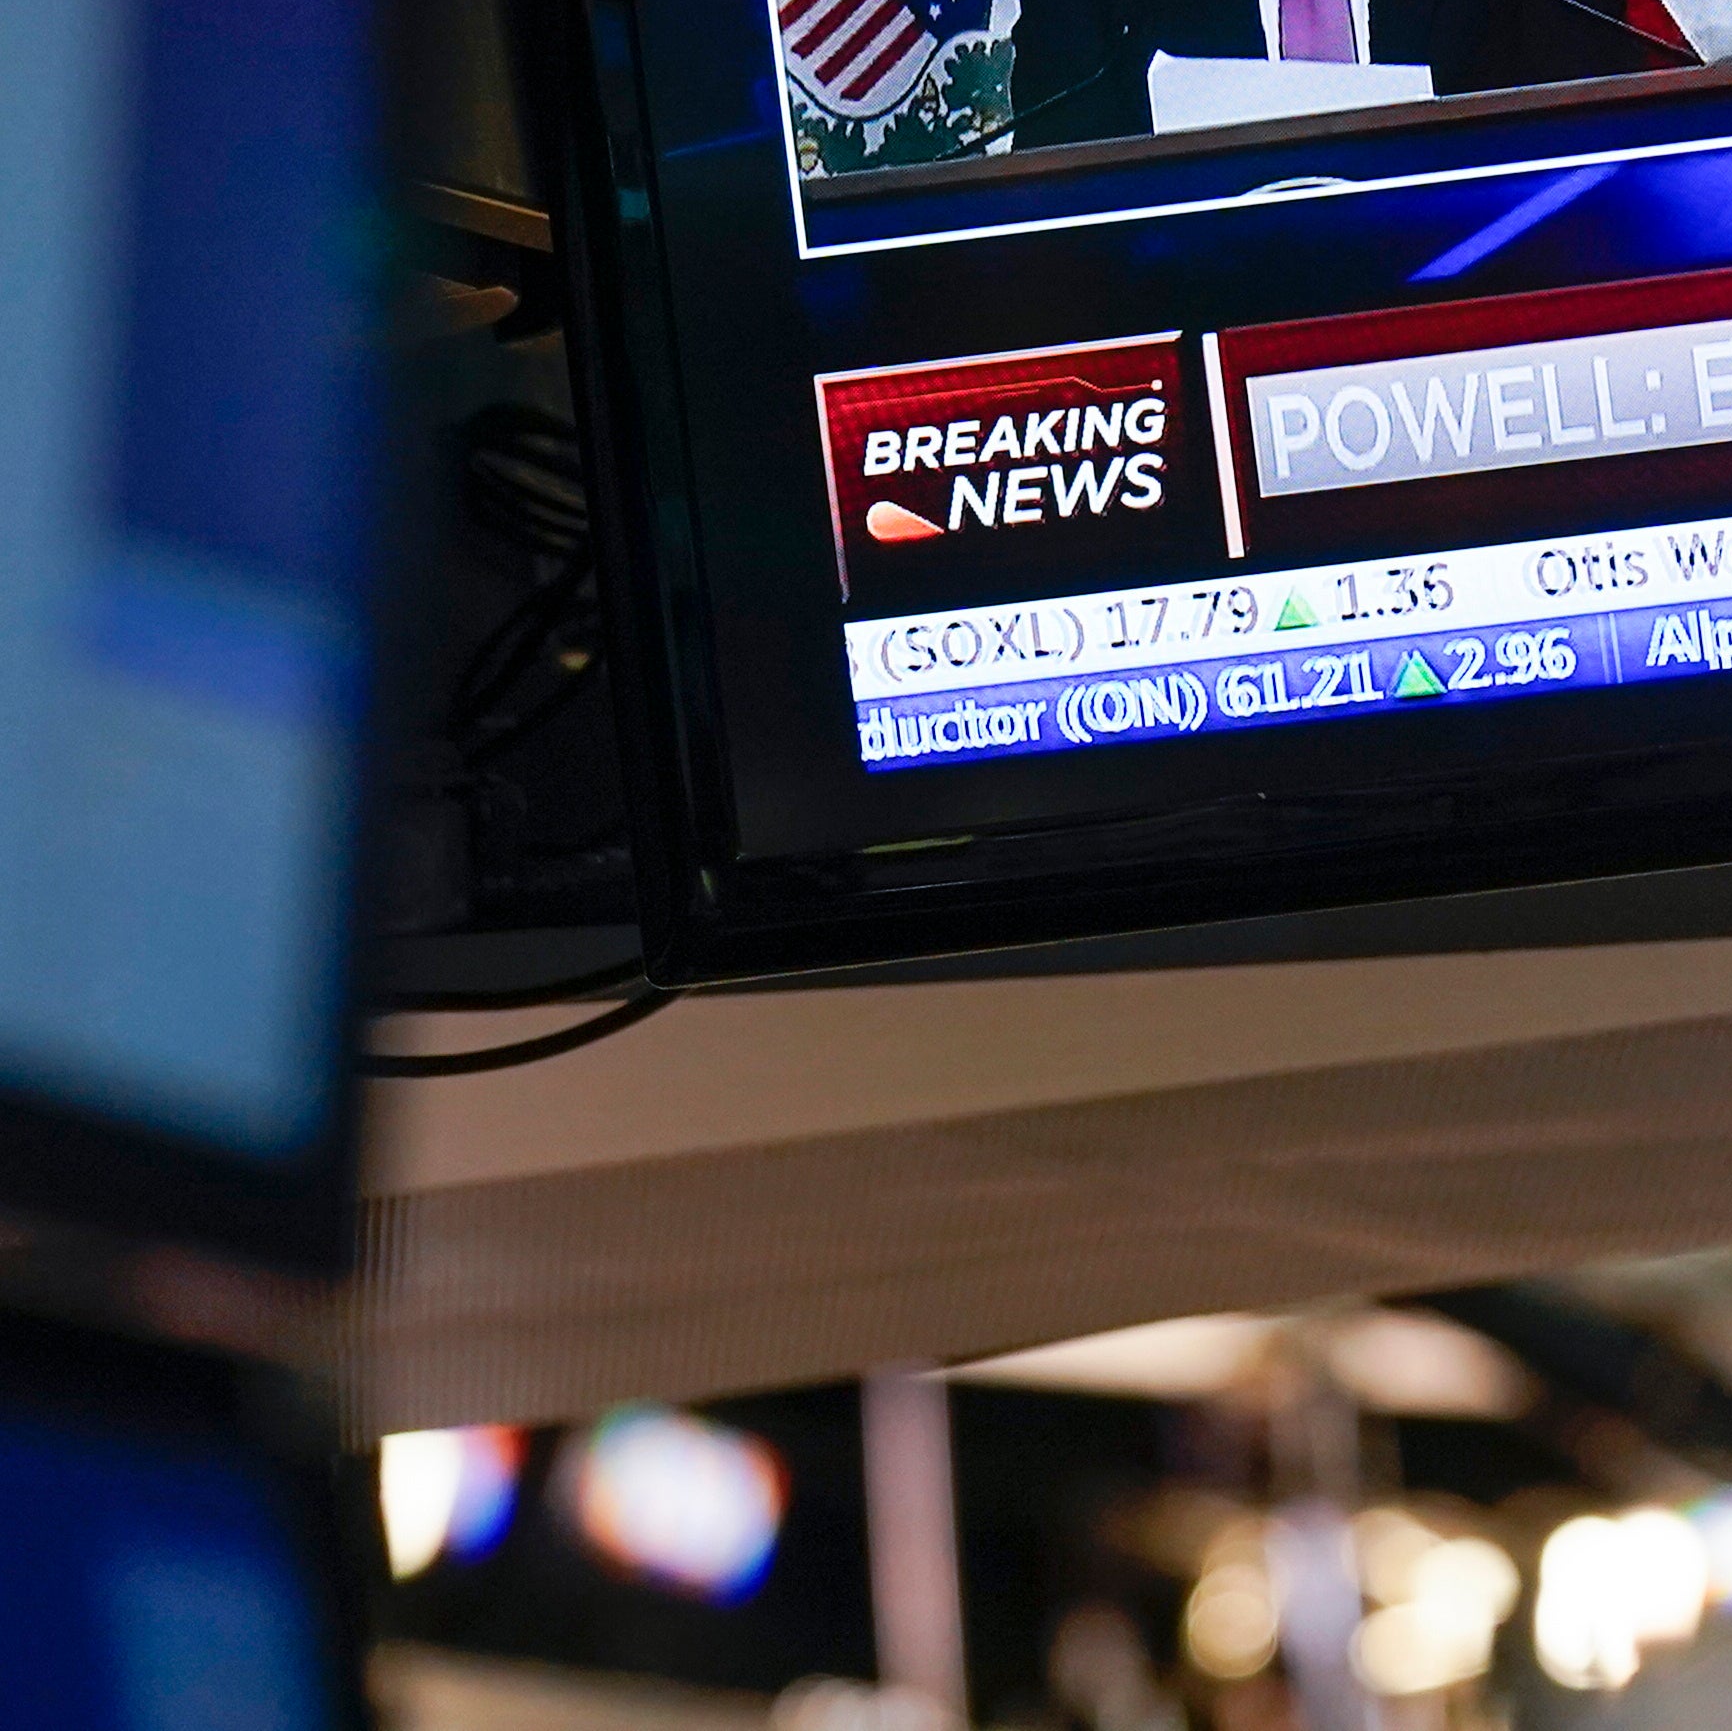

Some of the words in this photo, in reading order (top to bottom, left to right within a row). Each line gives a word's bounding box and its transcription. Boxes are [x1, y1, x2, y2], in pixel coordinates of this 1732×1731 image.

[863, 397, 1166, 477] BREAKING
[1266, 356, 1667, 480] POWELL:
[947, 452, 1164, 532] NEWS
[881, 608, 1086, 682] (SOXL)
[1105, 585, 1259, 649] 17.79
[1335, 561, 1455, 622] 1.36
[1536, 542, 1649, 598] Otis
[1216, 651, 1384, 717] 61.21
[1442, 625, 1578, 691] 2.96
